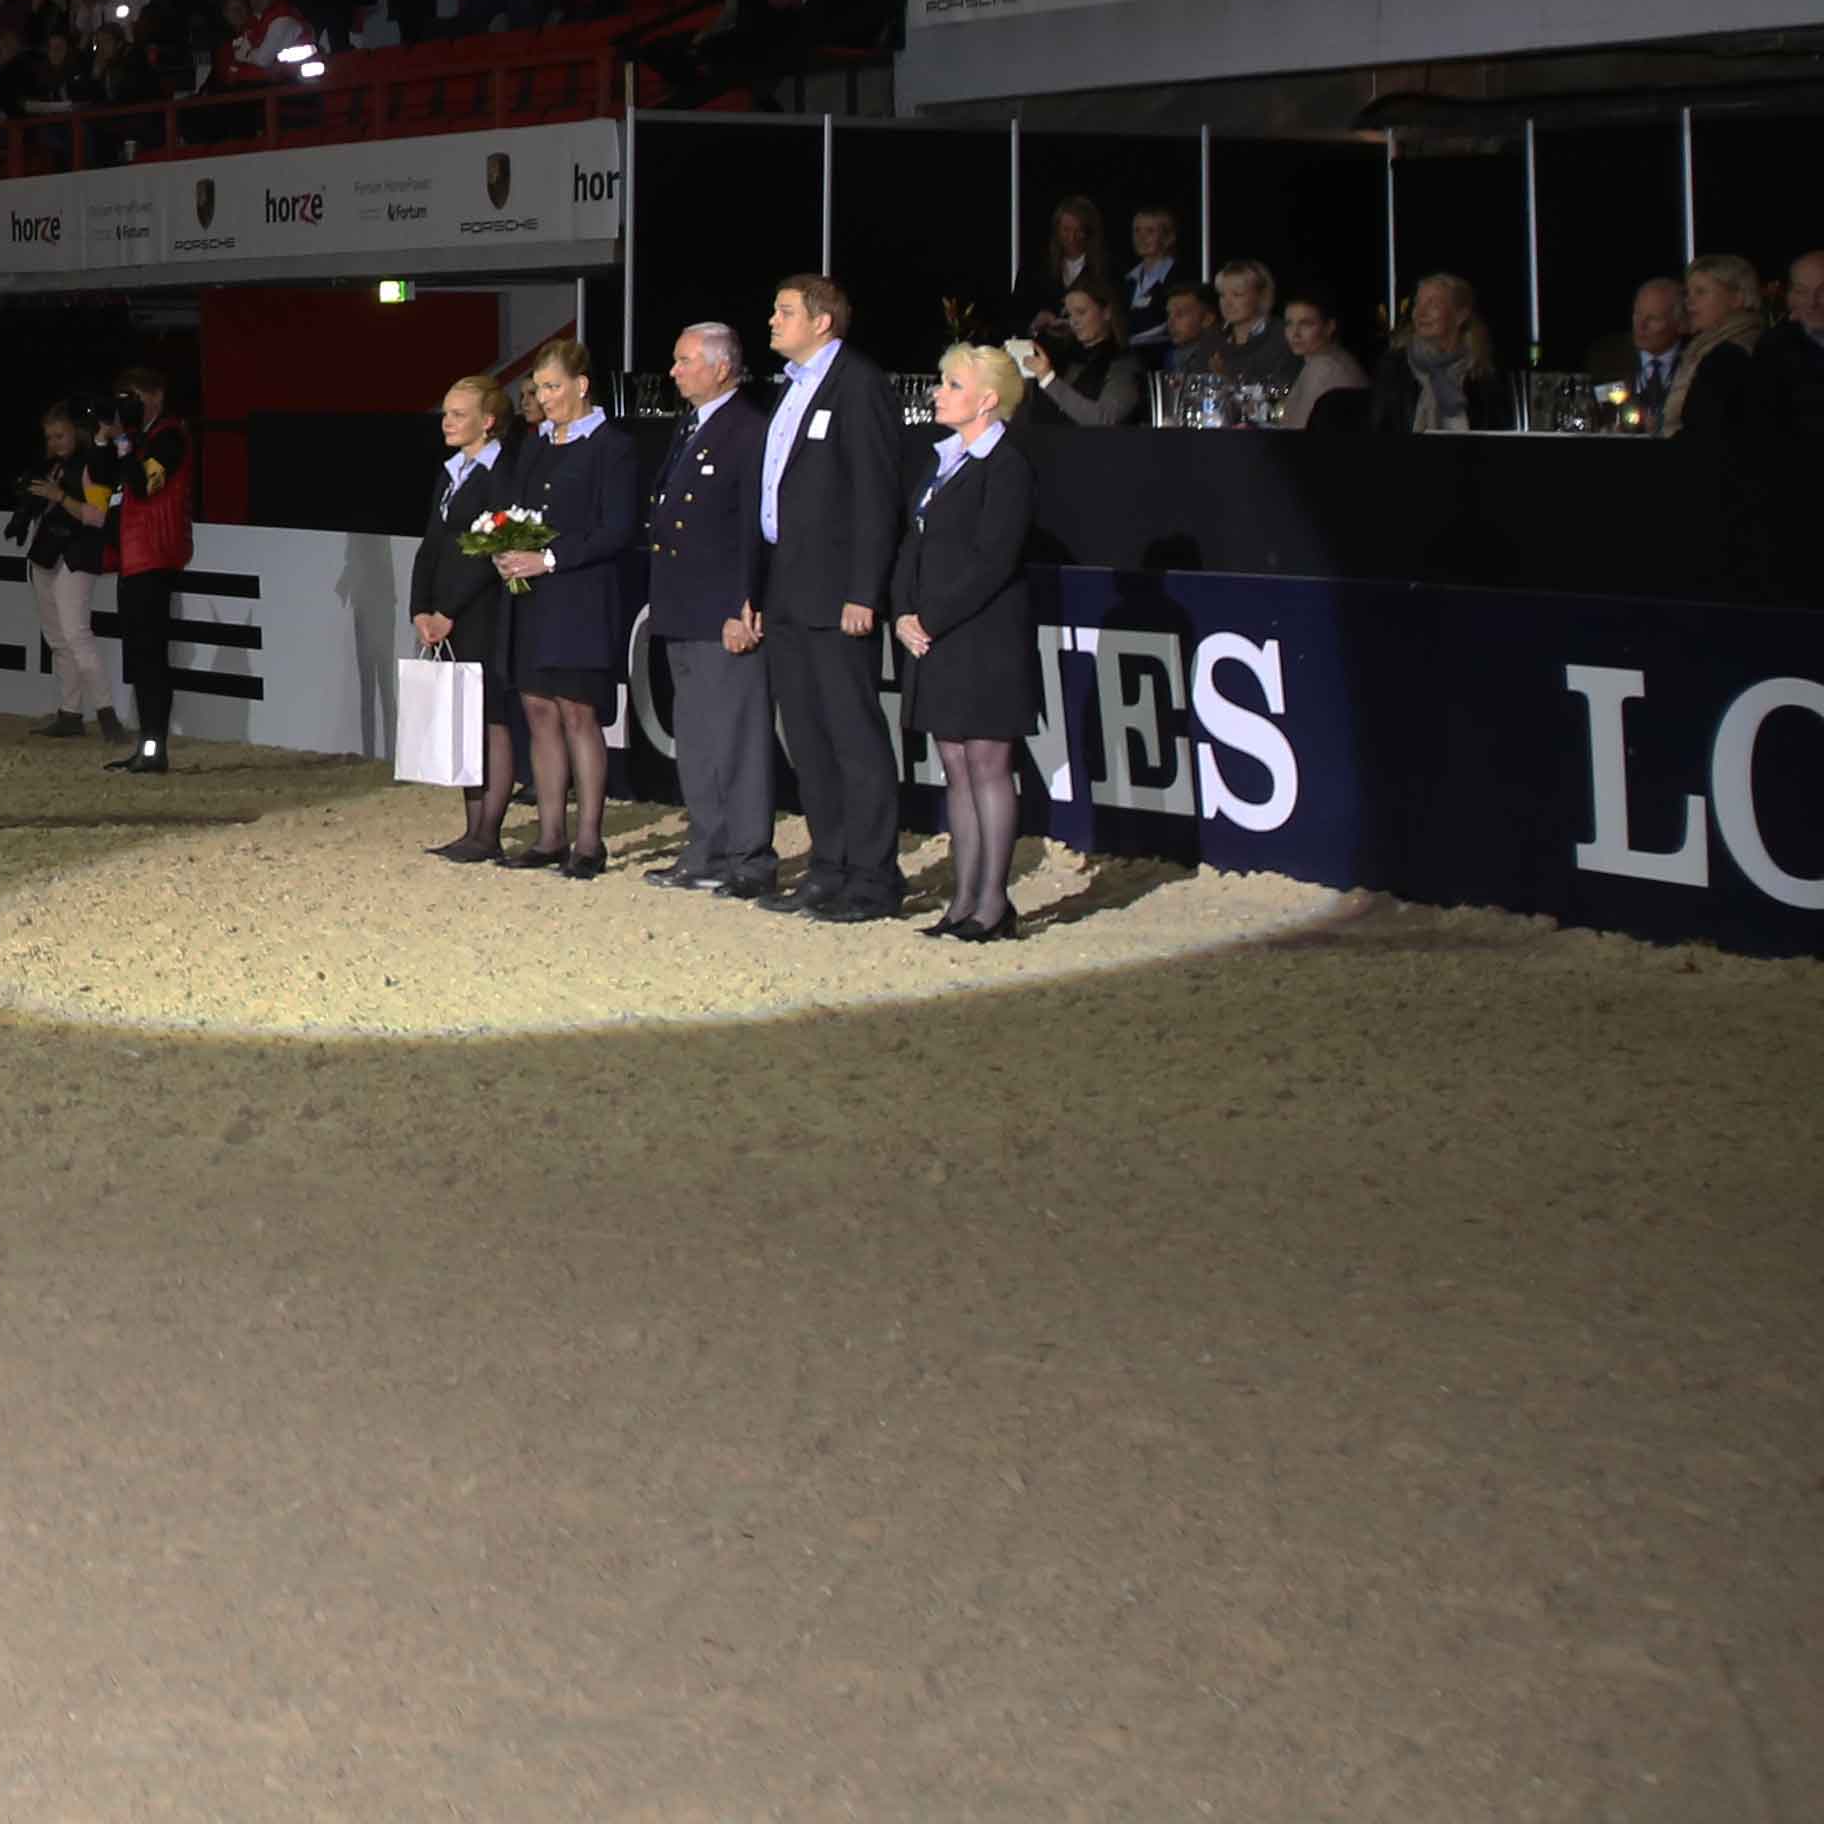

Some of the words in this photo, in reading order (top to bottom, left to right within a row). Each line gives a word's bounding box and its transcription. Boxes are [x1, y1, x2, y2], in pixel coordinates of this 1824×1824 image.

[265, 188, 325, 225] horze
[10, 210, 63, 245] horze
[459, 217, 540, 235] PORSCHE
